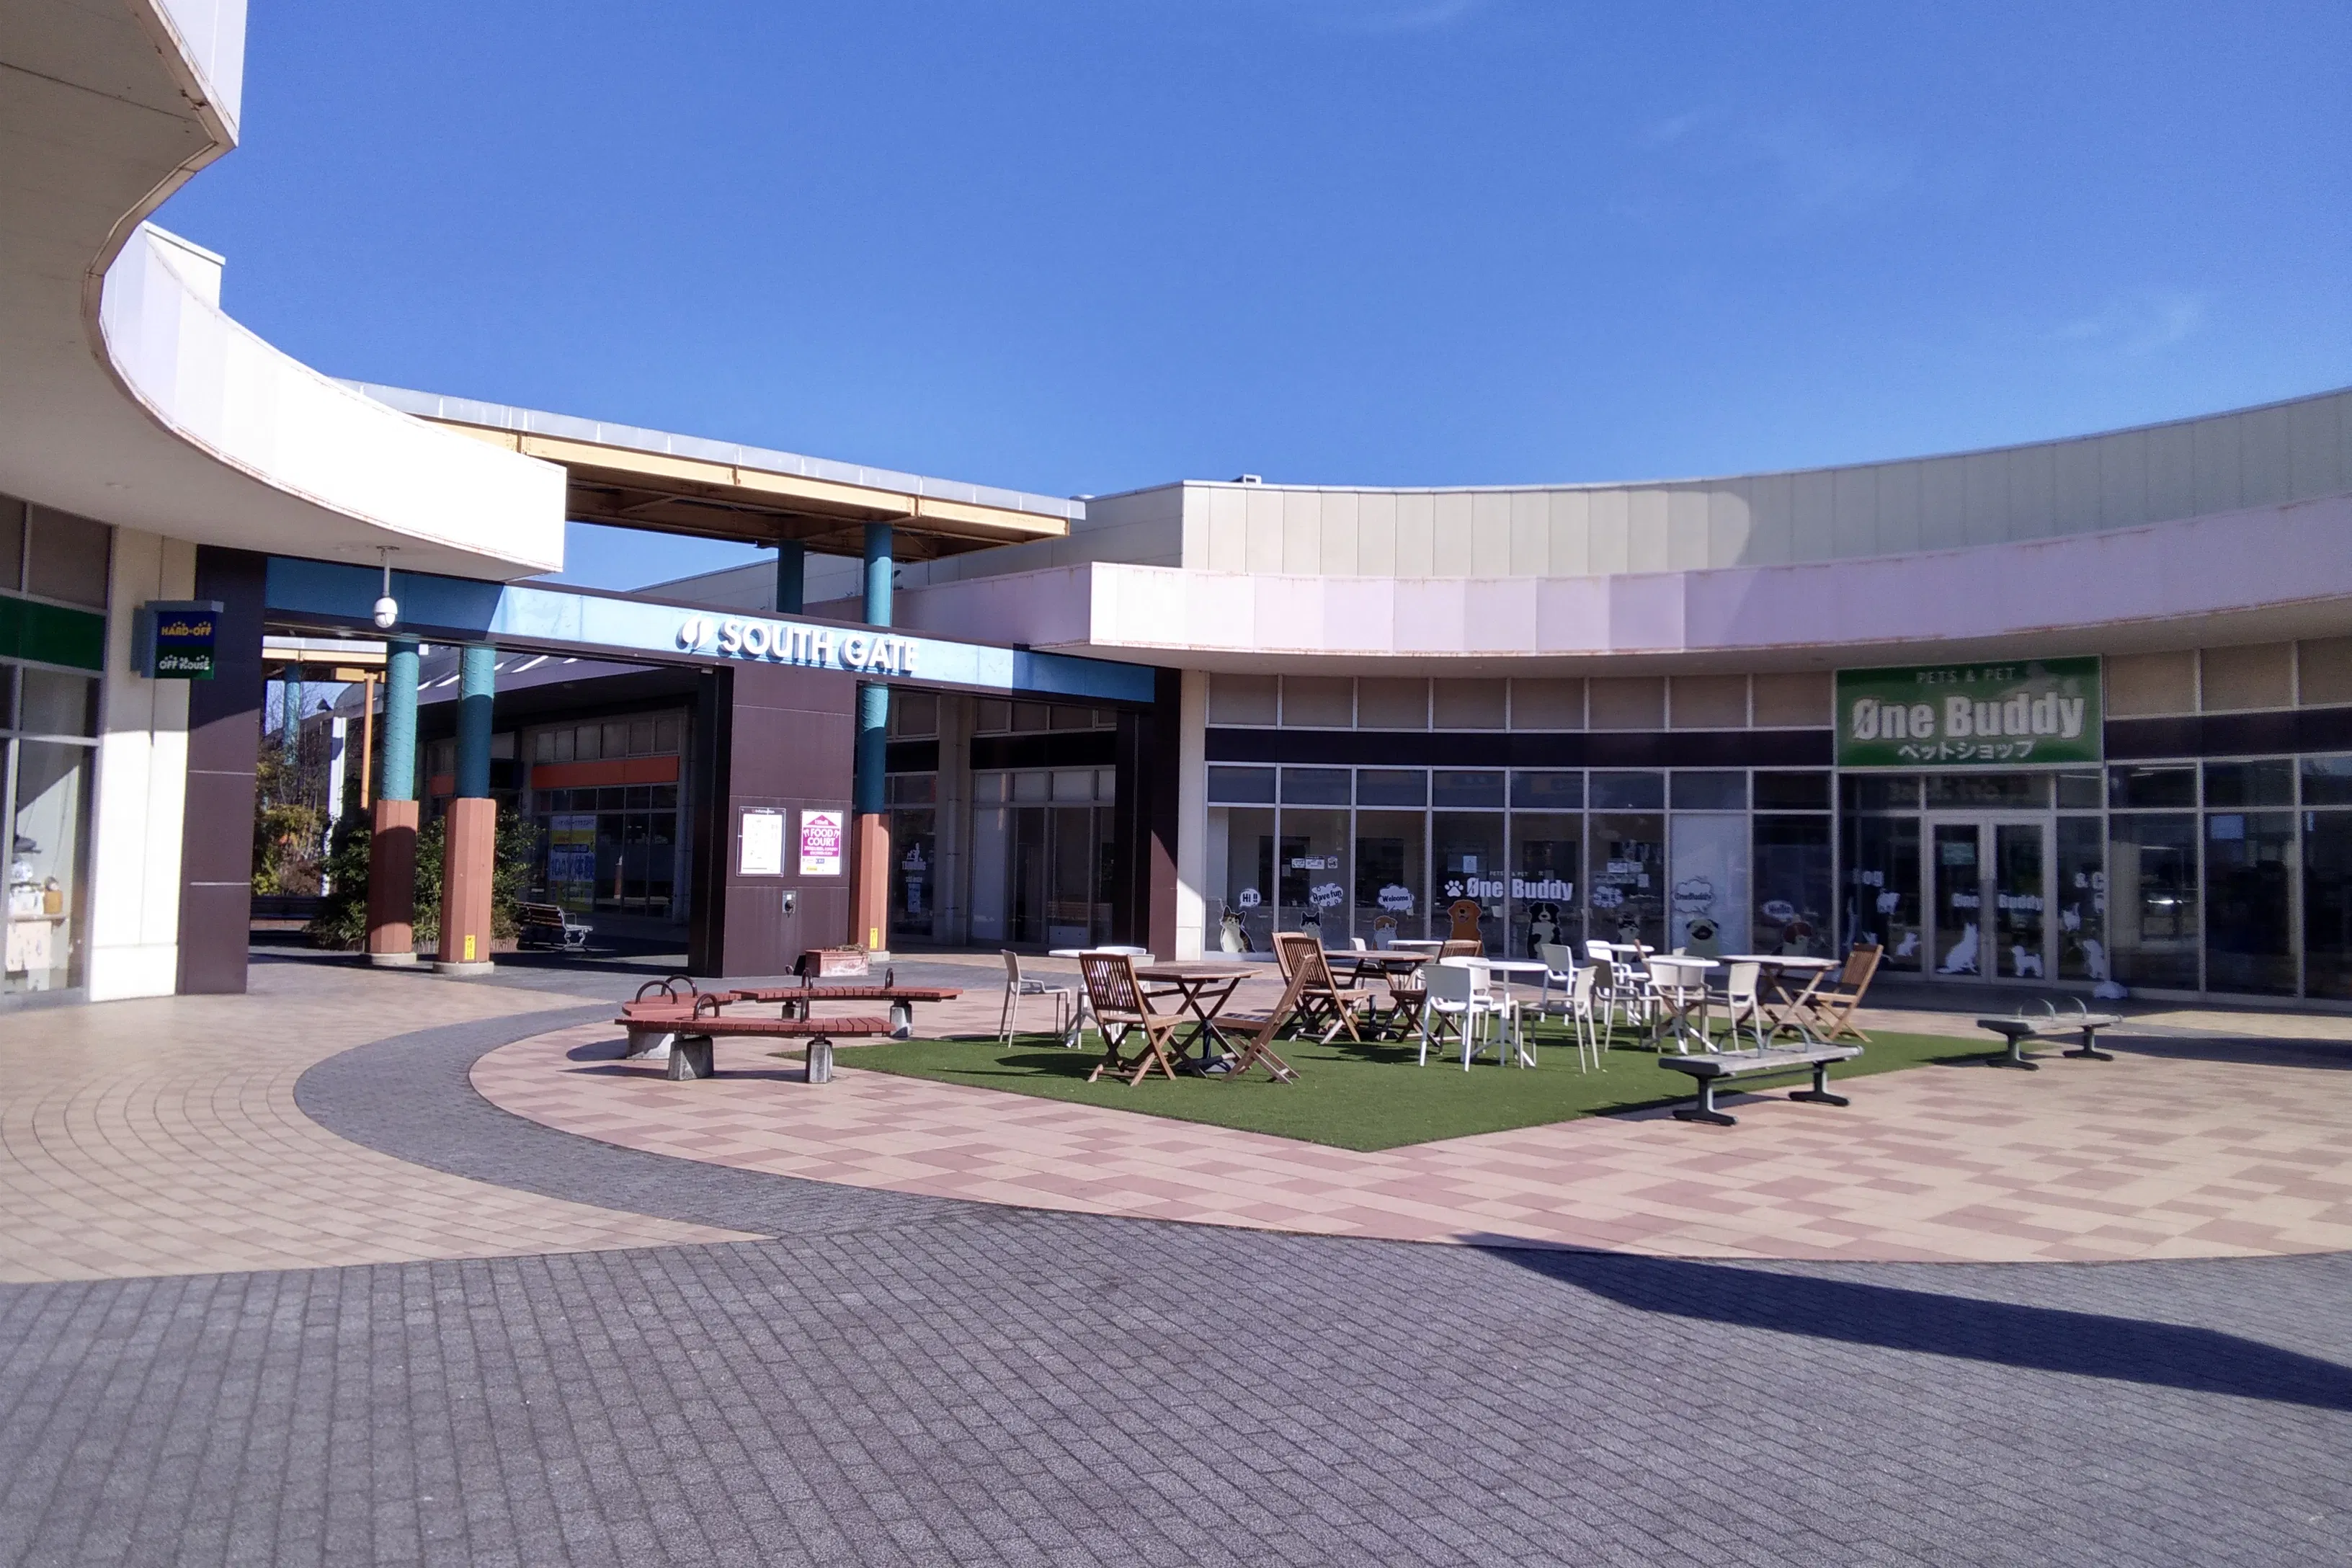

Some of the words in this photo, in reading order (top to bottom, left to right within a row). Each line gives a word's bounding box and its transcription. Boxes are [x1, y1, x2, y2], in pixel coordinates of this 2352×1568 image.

[161, 626, 212, 636] HARD-OFF
[719, 618, 834, 662] SOUTH
[840, 633, 919, 671] GATE
[159, 660, 178, 669] OFF
[179, 659, 210, 670] HOUSE
[1916, 670, 1958, 684] PETS
[1964, 669, 1976, 682] &
[1983, 667, 2016, 680] PET
[1946, 691, 2085, 739] Buddy
[1897, 739, 2037, 760] ペットショップ
[810, 828, 834, 838] FOOD
[807, 837, 836, 847] COURT
[1312, 892, 1330, 903] Have
[1330, 889, 1342, 899] fun
[1511, 878, 1573, 901] Buddy
